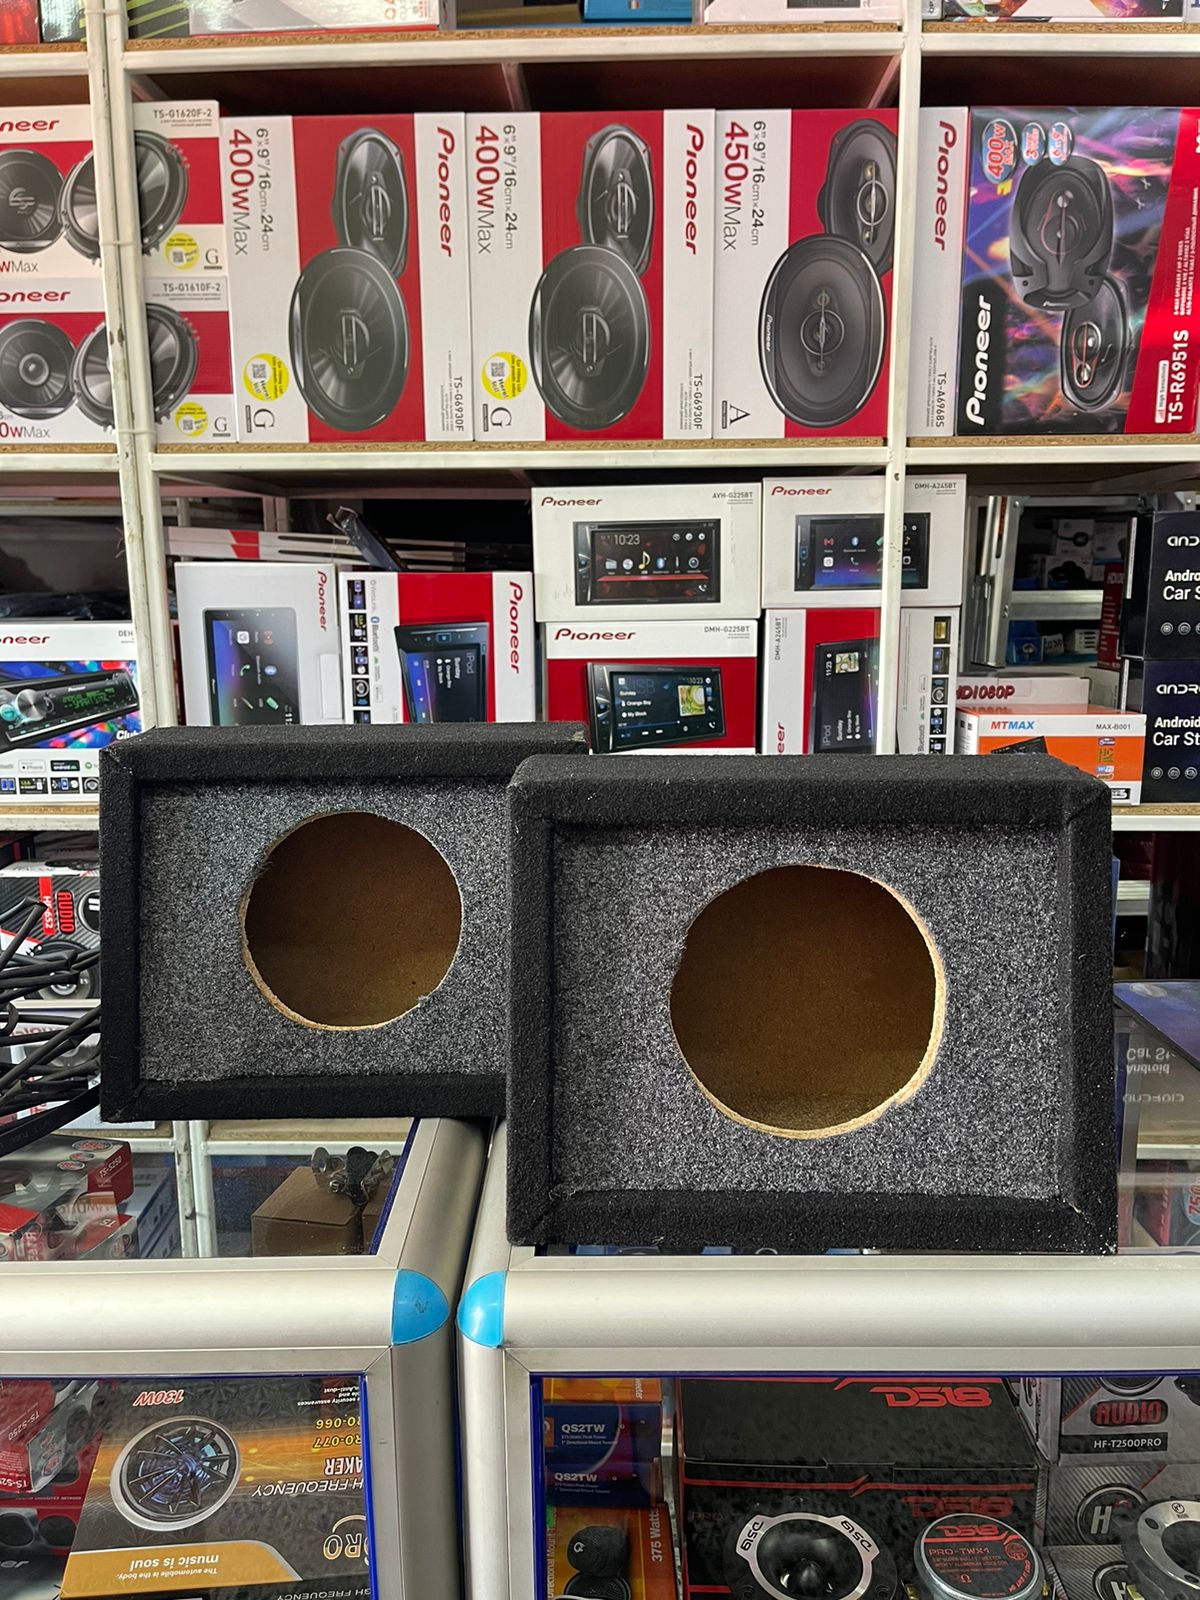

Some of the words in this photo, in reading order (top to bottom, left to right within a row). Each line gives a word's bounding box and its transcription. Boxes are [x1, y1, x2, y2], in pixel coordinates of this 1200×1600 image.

[436, 126, 456, 258] Pioneer
[686, 123, 704, 256] Pioneer
[934, 120, 957, 250] Pioneer
[966, 294, 992, 426] Pioneer
[1168, 329, 1190, 424] TS-R6951S
[453, 376, 464, 432] TS-G6930F
[692, 374, 704, 430] TS-G6930F
[936, 372, 947, 428] TS-A6968S
[712, 492, 753, 500] AVH-G225BT
[772, 486, 832, 496] Pioneer
[541, 496, 602, 507] Pioneer
[614, 534, 640, 545] 10:23
[318, 570, 328, 632] Pioneer
[1163, 586, 1191, 600] Car
[509, 581, 523, 674] Pioneer
[554, 628, 636, 640] Pioneer
[0, 636, 50, 644] neer
[466, 652, 475, 674] iPod
[990, 720, 1035, 730] MTMAX
[1154, 716, 1200, 728] Android
[822, 724, 832, 746] iPod
[1153, 732, 1180, 746] Car
[58, 891, 75, 932] AUDIO
[132, 1389, 184, 1407] 130W
[869, 1386, 993, 1408] DS18
[1095, 1402, 1162, 1424] AUDIO
[562, 1424, 605, 1434] QS2TW
[1094, 1438, 1162, 1449] HF-T2500PRO
[324, 1456, 364, 1475] AKER
[554, 1472, 598, 1482] QS2TW
[323, 1533, 369, 1564] RO
[652, 1541, 662, 1562] 375
[0, 1560, 29, 1568] er
[130, 1559, 160, 1572] soul
[163, 1558, 174, 1569] is
[178, 1555, 220, 1566] music
[161, 1568, 203, 1578] automobile
